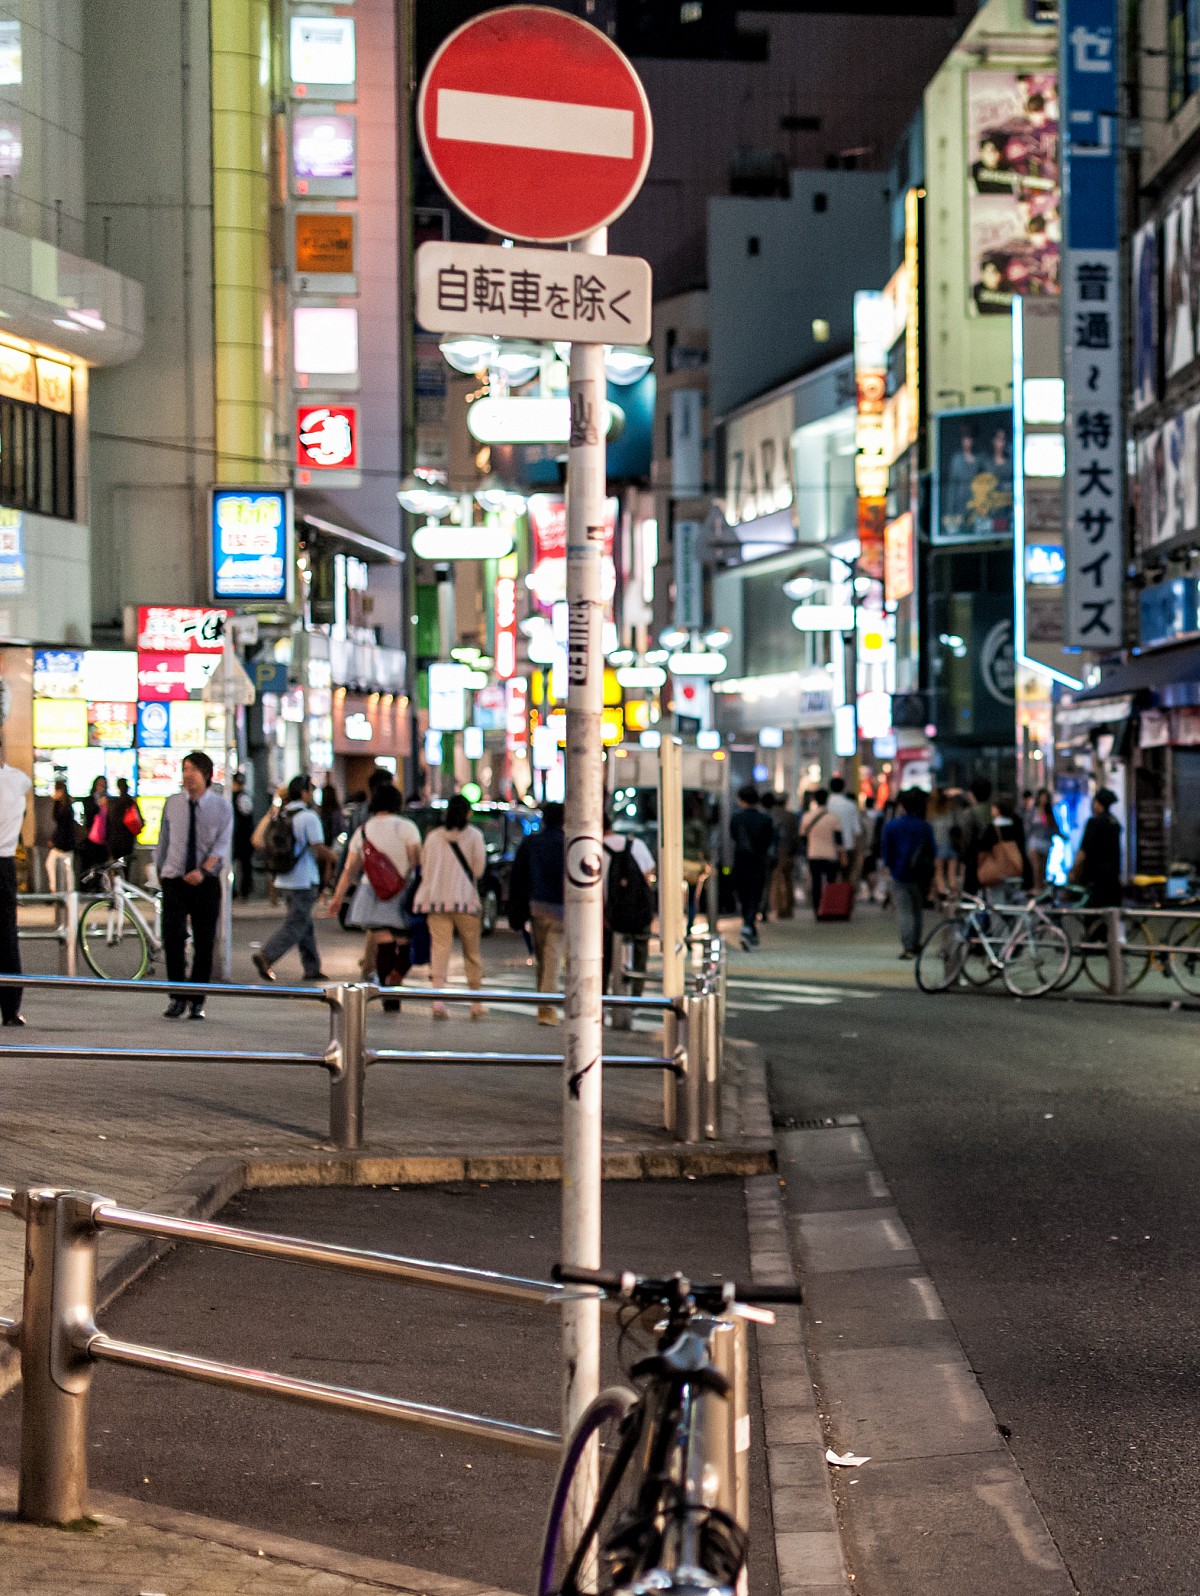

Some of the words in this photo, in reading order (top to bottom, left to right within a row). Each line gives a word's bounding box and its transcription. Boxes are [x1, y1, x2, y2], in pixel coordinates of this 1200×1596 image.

[437, 264, 632, 324] 自転車を除く
